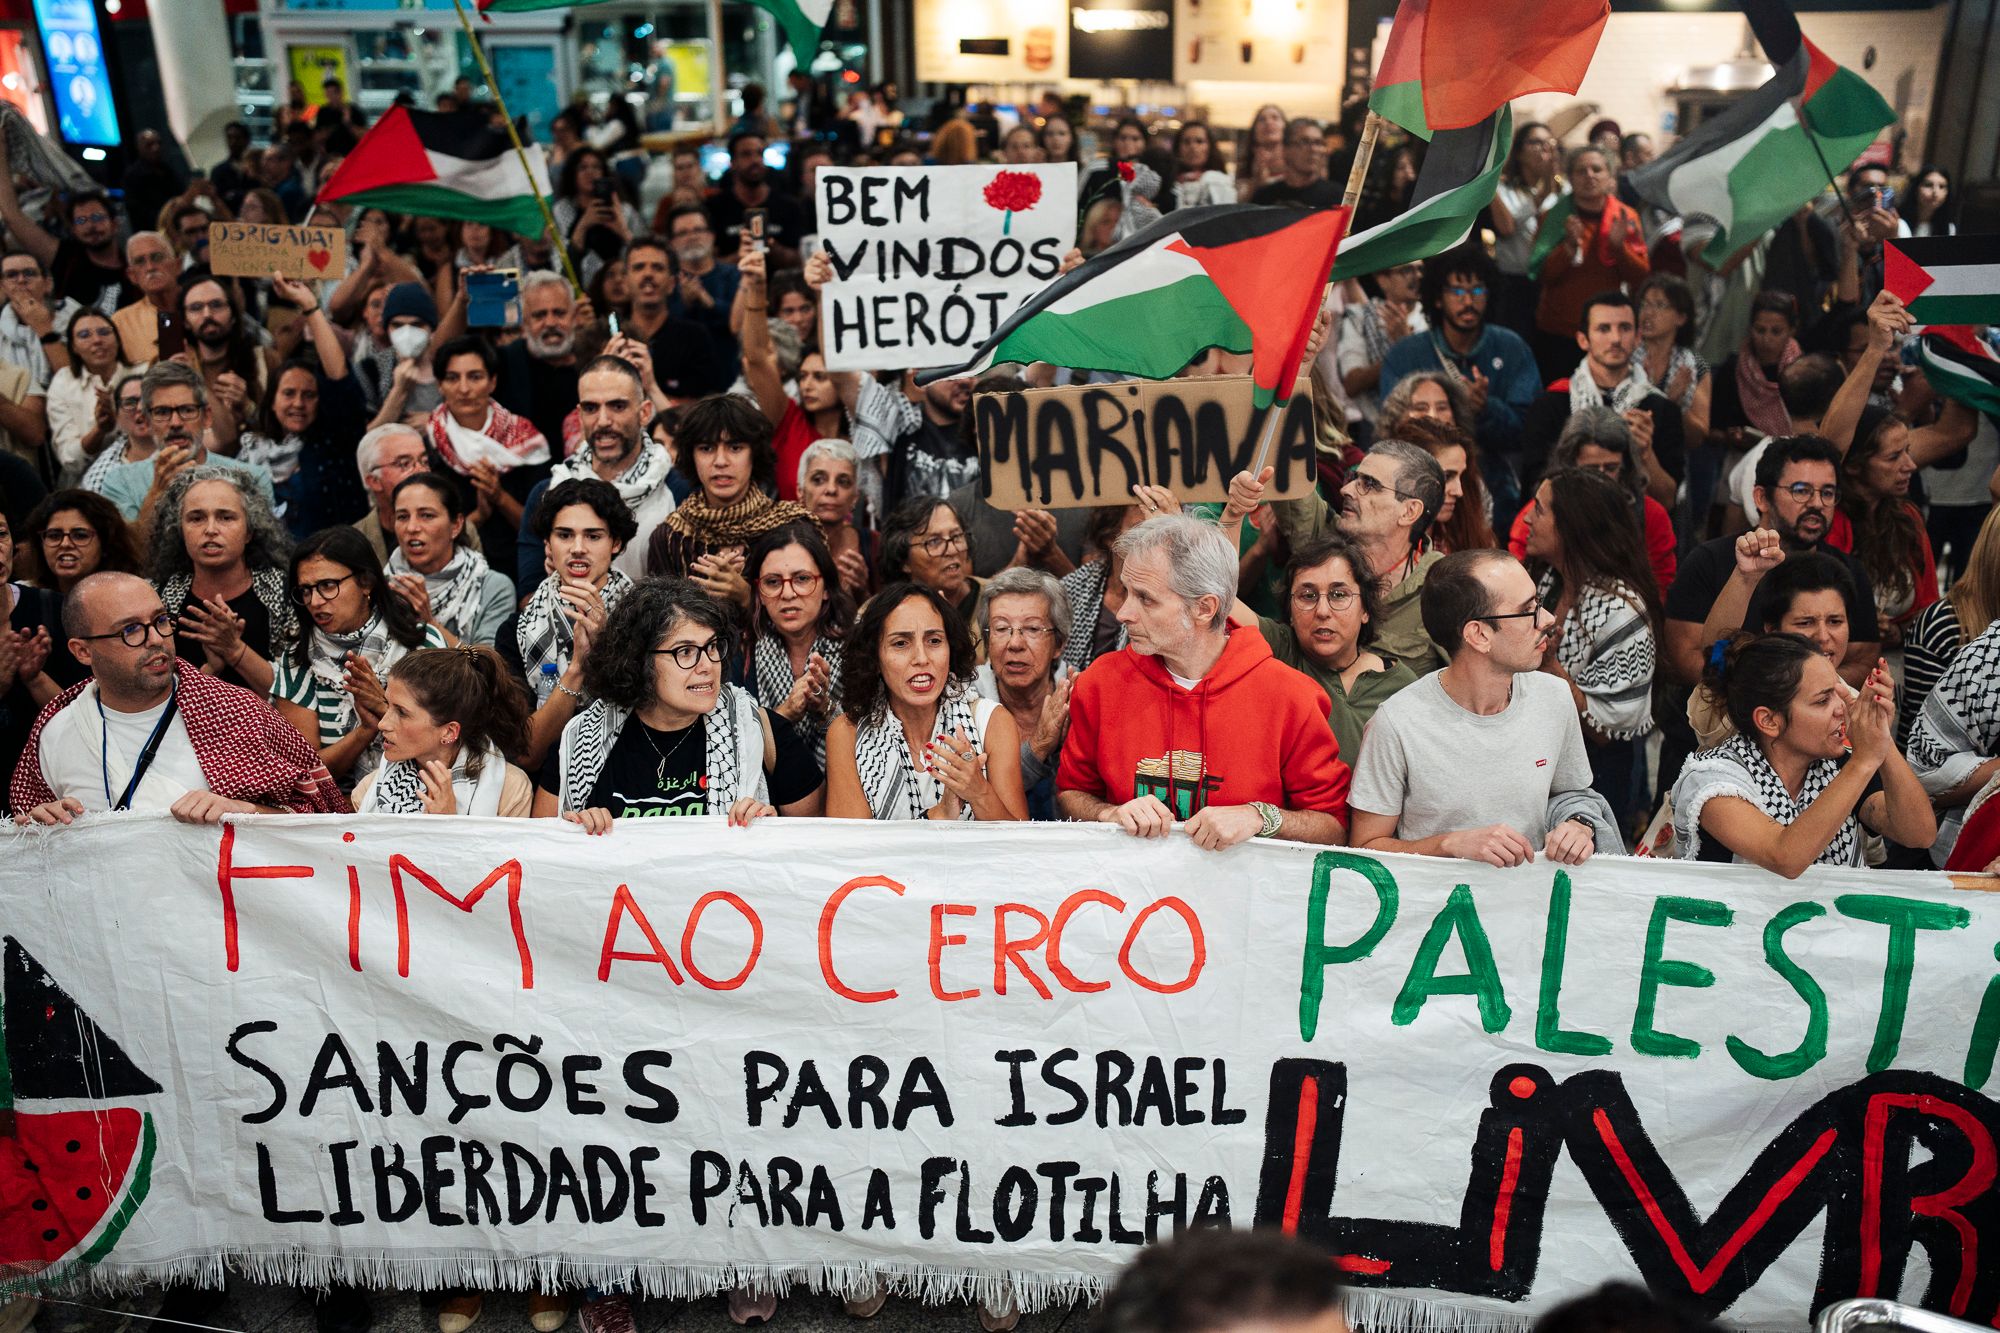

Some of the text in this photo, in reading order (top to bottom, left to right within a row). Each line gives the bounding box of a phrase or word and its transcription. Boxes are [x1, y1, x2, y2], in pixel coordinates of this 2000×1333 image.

[822, 174, 931, 227] BEM
[214, 223, 334, 250] OBRIGADA!
[822, 237, 1061, 284] VINDOS
[833, 283, 1036, 354] HERÓI
[598, 885, 763, 990] AO
[818, 875, 1206, 1003] CERCO
[226, 1020, 1246, 1131] SANÇÕES PARA ISRAEL
[256, 1136, 1232, 1245] LIBERDADE PARA A FLOTILHA
